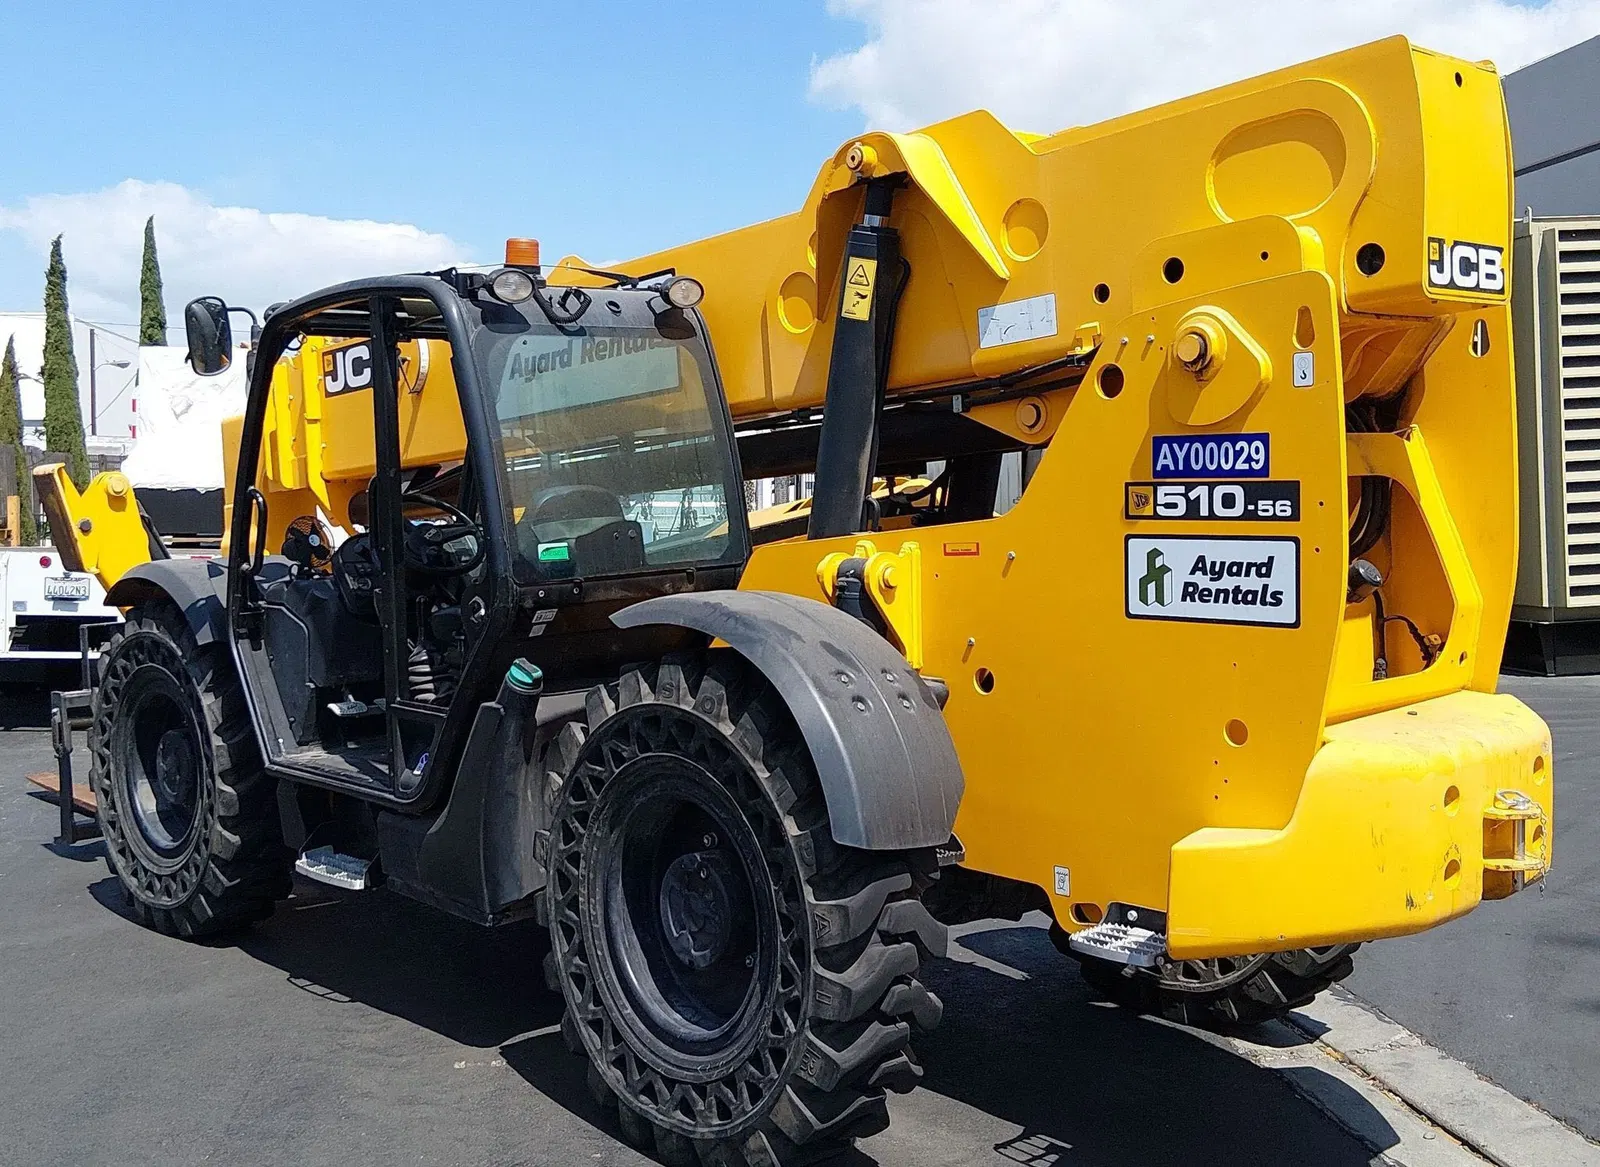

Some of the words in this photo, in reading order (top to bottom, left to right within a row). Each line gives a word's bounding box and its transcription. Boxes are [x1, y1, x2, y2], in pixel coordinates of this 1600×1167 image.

[1430, 244, 1503, 290] JCB
[325, 345, 372, 393] JC
[508, 338, 573, 384] Ayard
[1156, 440, 1265, 471] AY00029
[1156, 484, 1292, 517] 510-56
[1189, 555, 1275, 582] Ayard
[1181, 581, 1284, 607] Rentals
